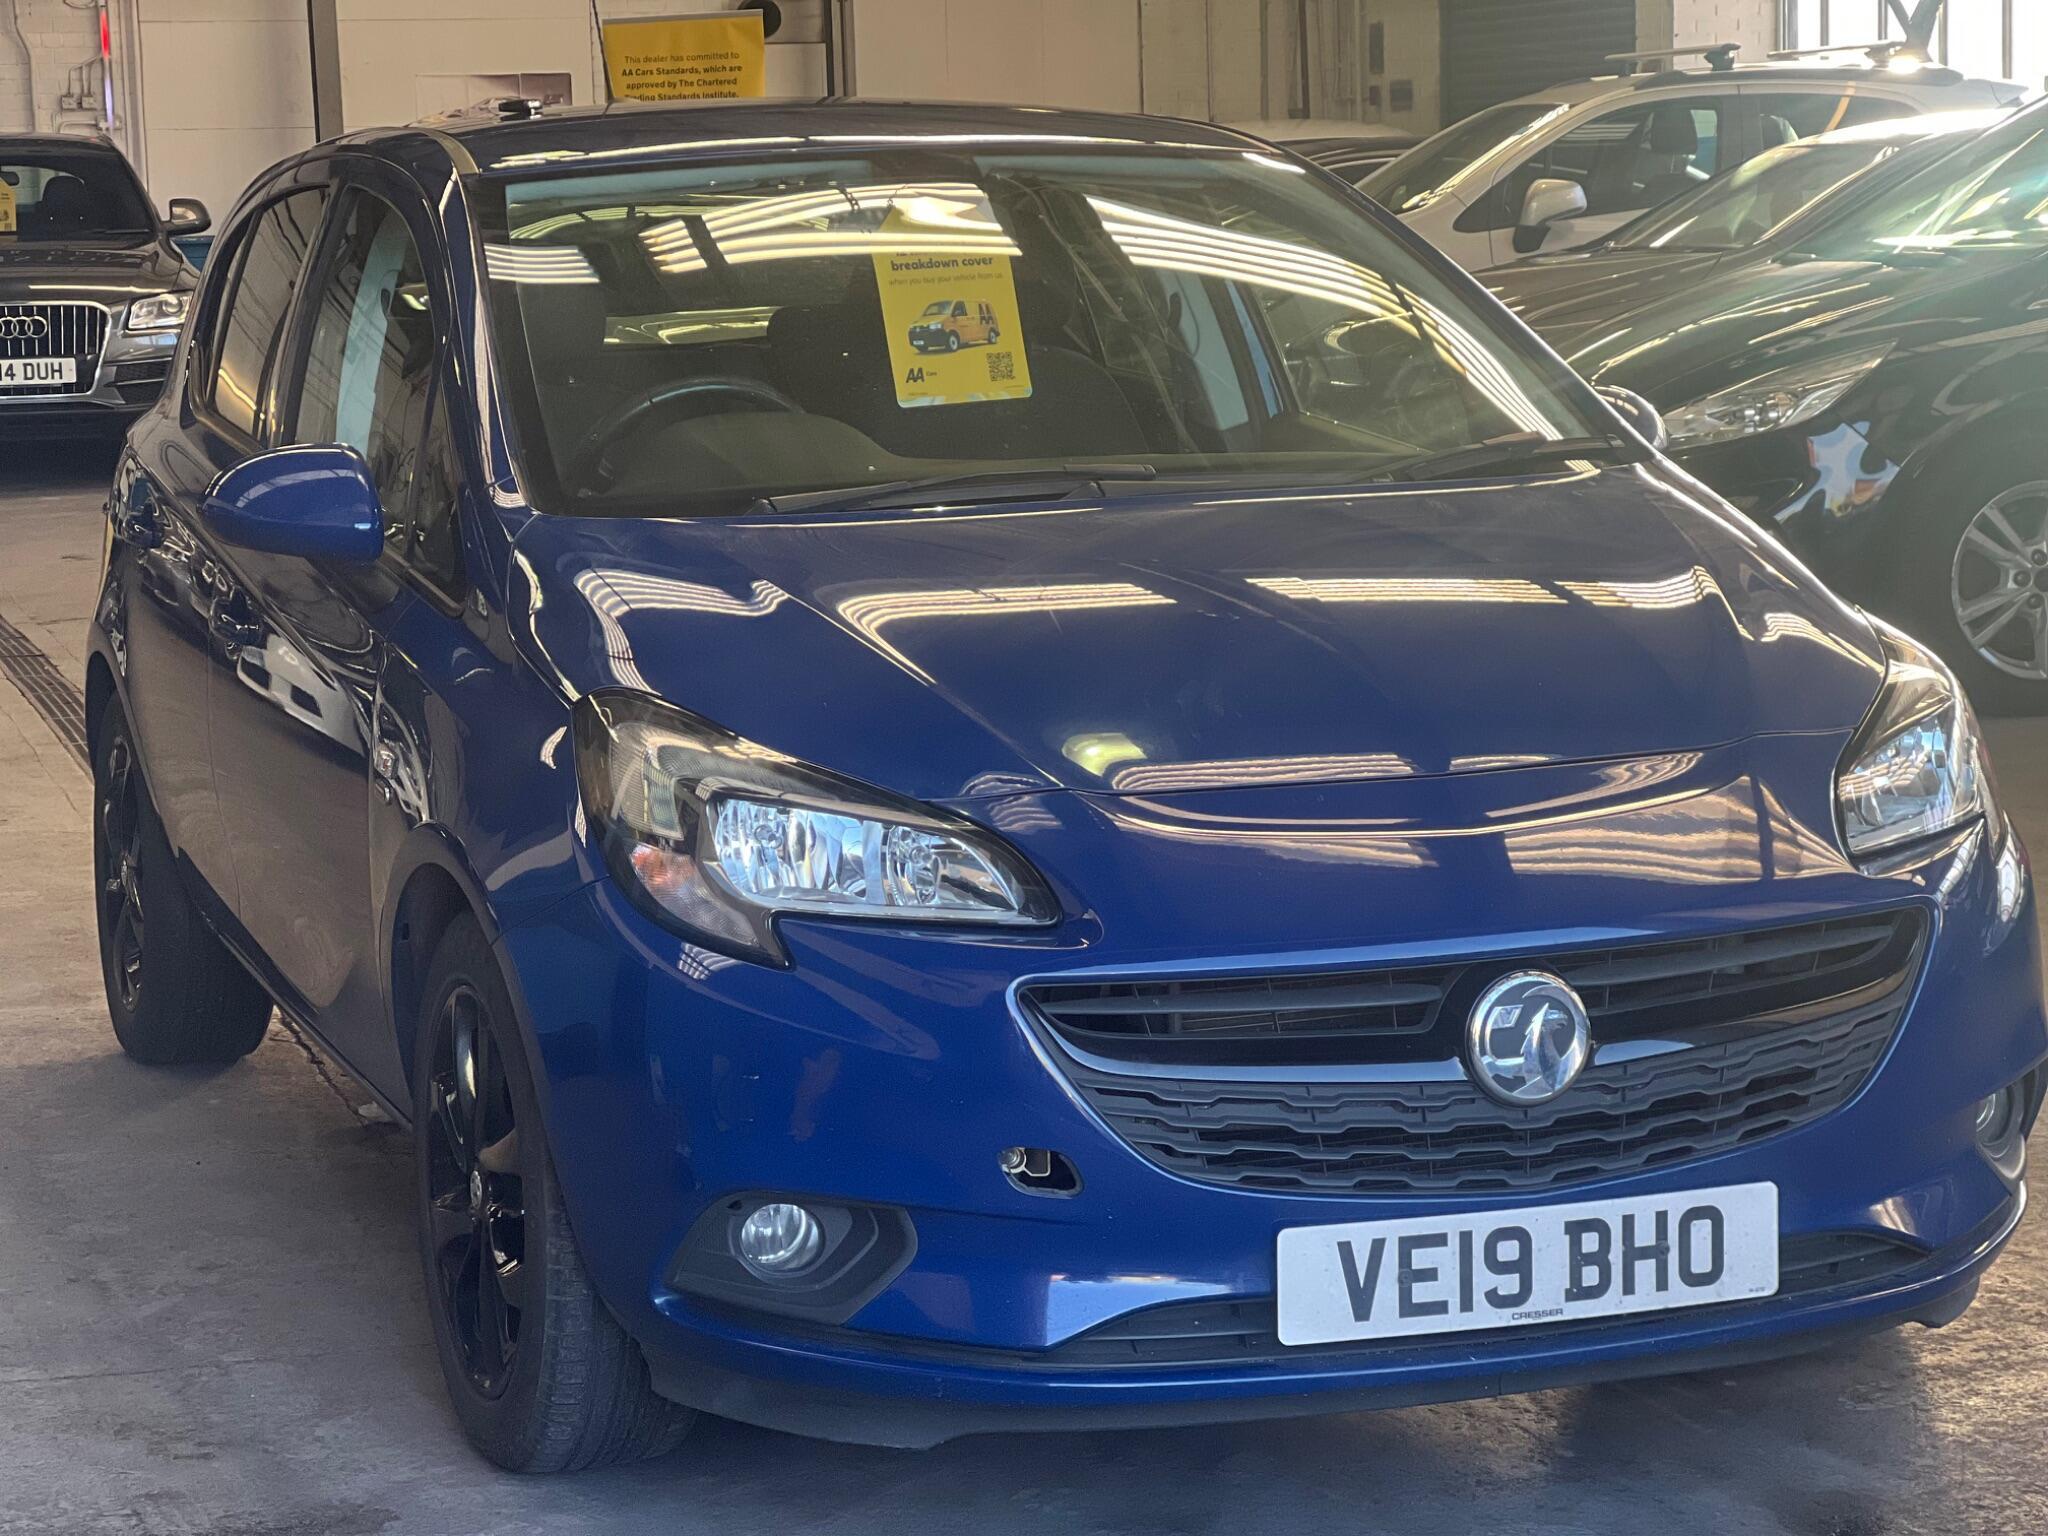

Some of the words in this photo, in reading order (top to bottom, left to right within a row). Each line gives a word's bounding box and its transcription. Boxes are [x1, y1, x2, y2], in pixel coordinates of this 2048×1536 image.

[624, 55, 641, 64] This
[643, 54, 668, 63] dealer
[670, 54, 684, 62] has
[686, 51, 729, 61] committed
[730, 51, 740, 60] to
[622, 68, 634, 76] AA
[635, 67, 654, 76] Cars
[655, 65, 702, 75] Standards,
[703, 64, 727, 73] which
[626, 80, 666, 90] approved
[667, 79, 677, 89] by
[678, 79, 695, 87] The
[696, 77, 738, 87] Chartered
[656, 91, 701, 101] Standards
[702, 90, 740, 99] Institute.
[890, 257, 959, 271] breakdown
[961, 256, 993, 266] cover
[888, 278, 908, 286] when
[909, 277, 921, 286] you
[922, 275, 936, 285] buy
[937, 275, 952, 283] your
[952, 272, 976, 282] vehicle
[977, 271, 993, 280] from
[23, 362, 63, 380] DUH
[905, 367, 925, 383] AA
[1336, 1225, 1533, 1323] VE19
[1564, 1204, 1725, 1303] BHO
